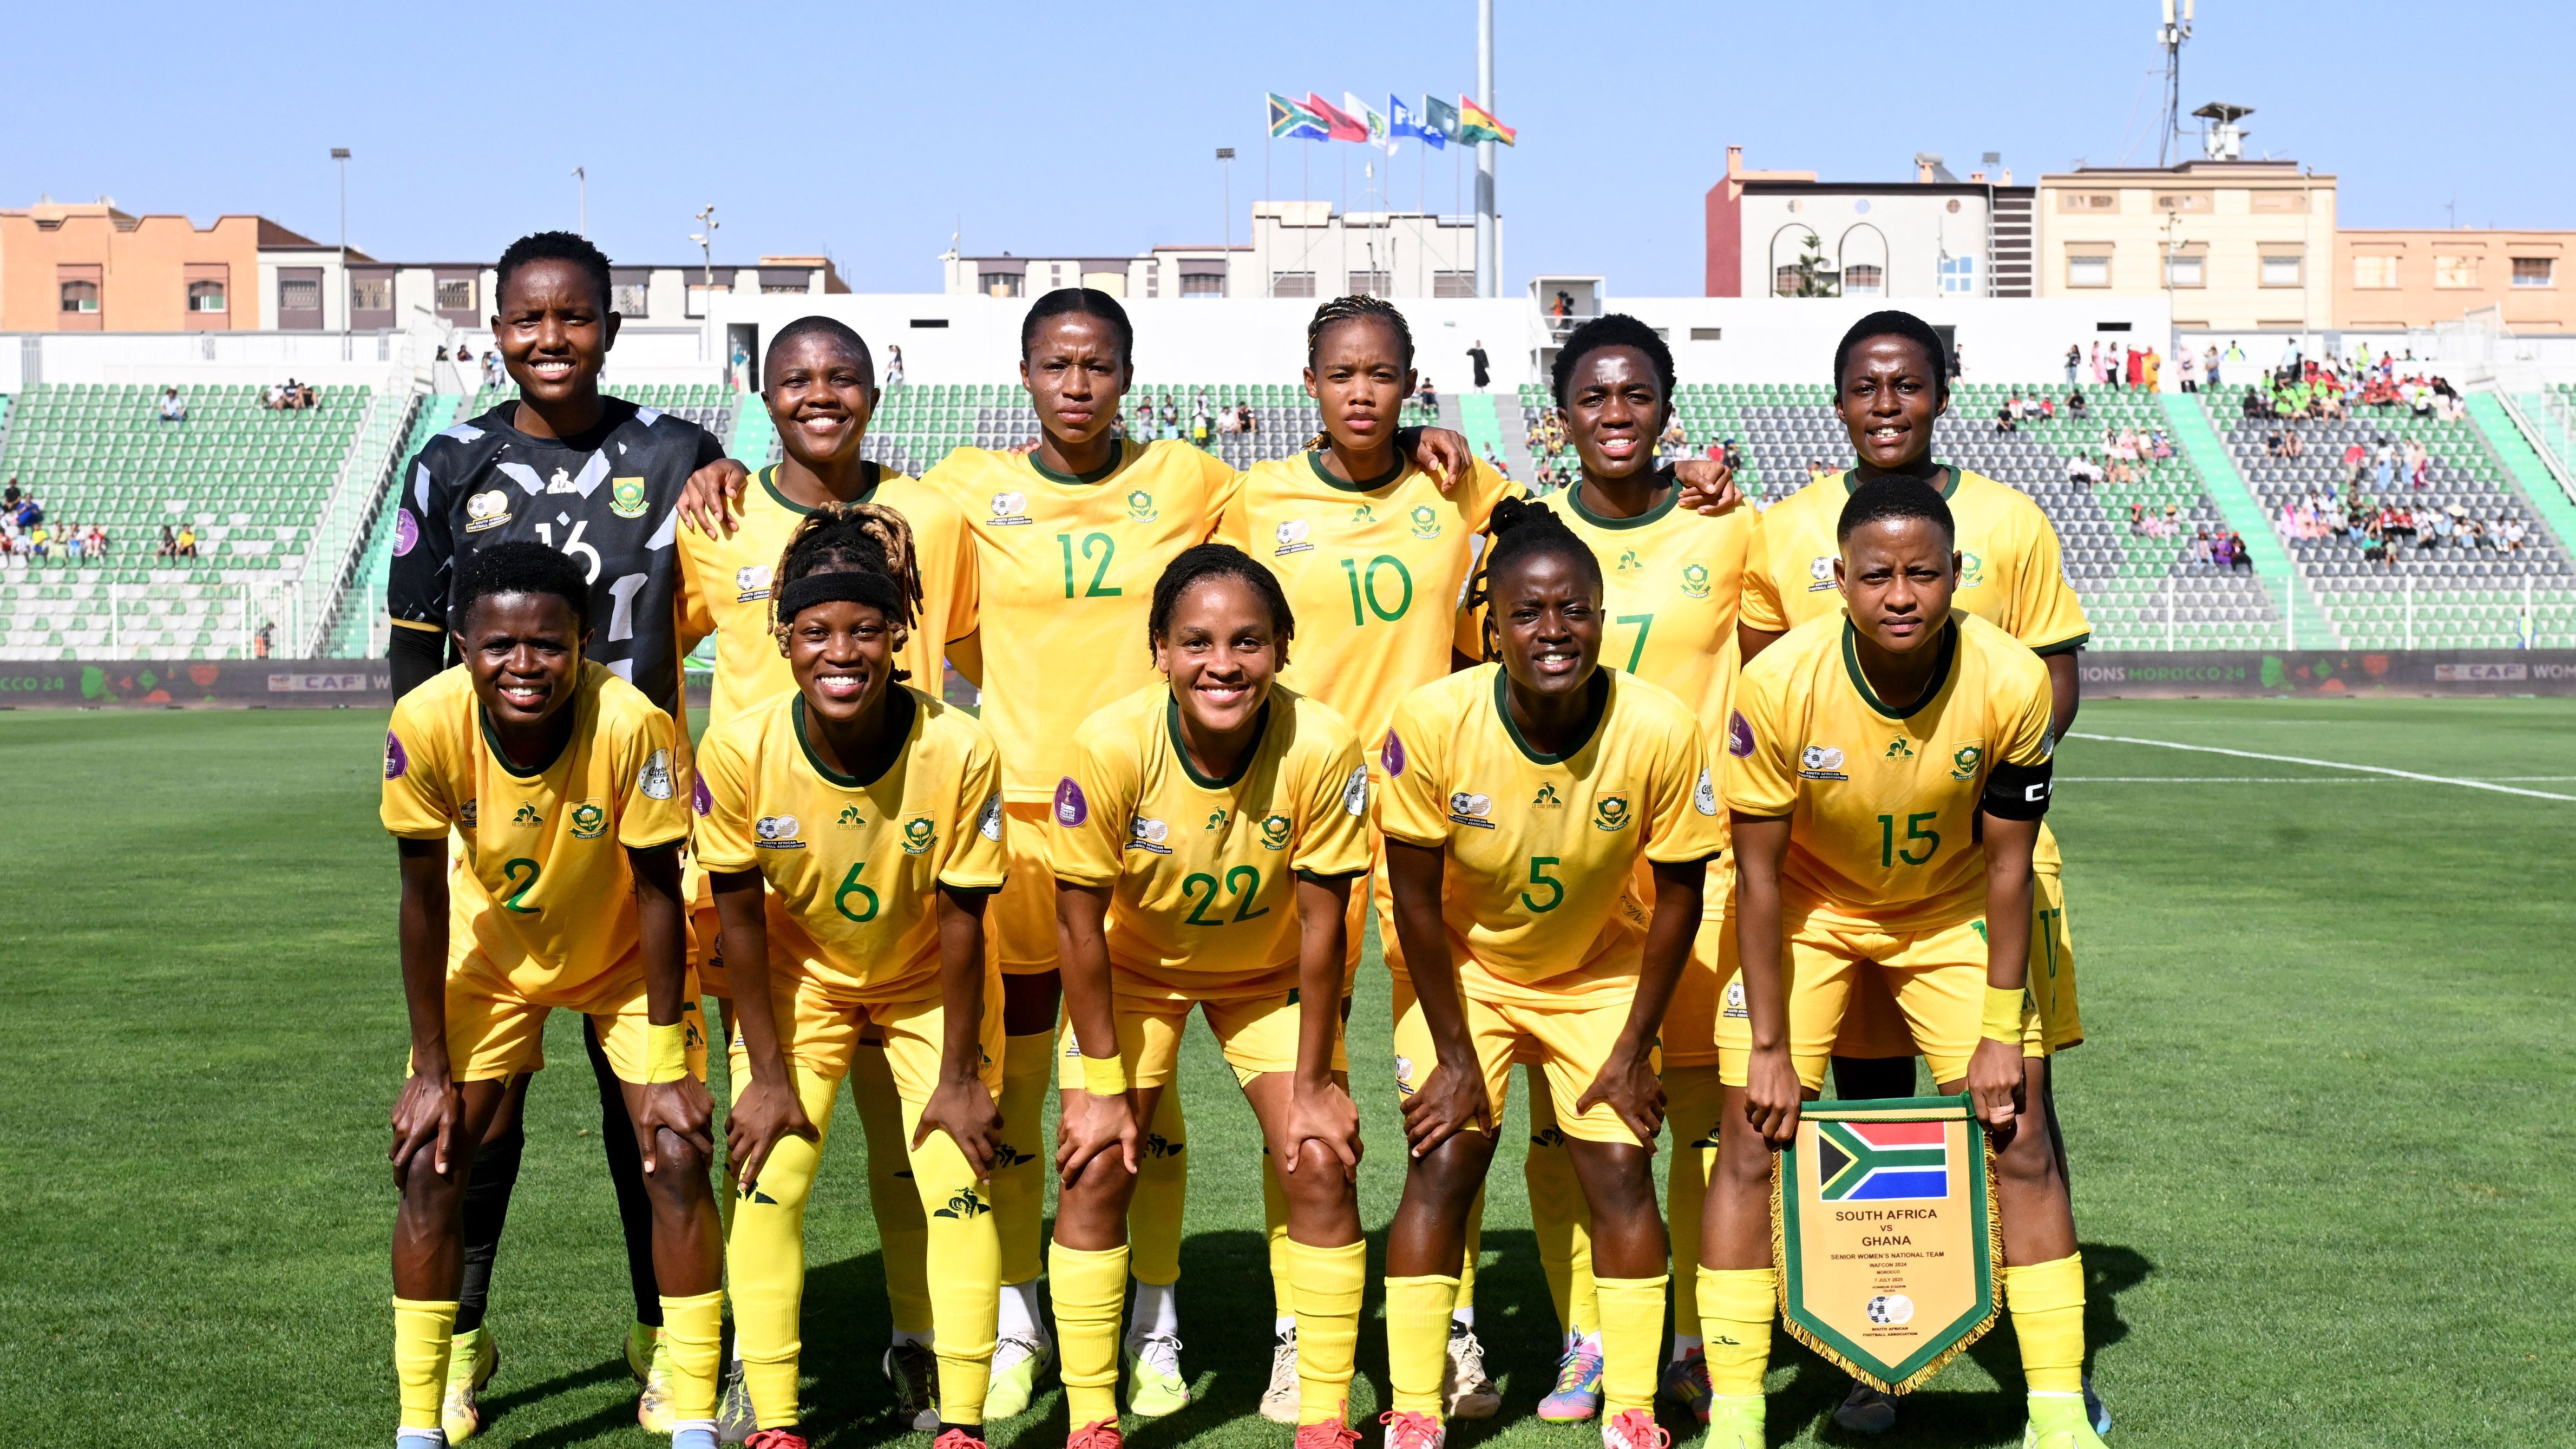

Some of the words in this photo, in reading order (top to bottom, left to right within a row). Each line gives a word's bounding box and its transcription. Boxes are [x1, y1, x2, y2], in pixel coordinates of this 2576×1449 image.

[1057, 532, 1122, 599] 12
[1341, 554, 1413, 626] 10
[1617, 614, 1654, 675] 7
[2127, 667, 2221, 681] MOROCCO
[2225, 666, 2246, 680] 24
[2469, 666, 2520, 678] CAF
[42, 676, 64, 691] 24
[304, 676, 356, 689] CAF
[1448, 816, 1467, 824] FOOTBALL
[1614, 821, 1627, 830] AFRICA
[592, 829, 607, 838] AFRICA
[1878, 811, 1940, 867] 15
[504, 858, 541, 914] 2
[834, 862, 879, 922] 6
[1522, 856, 1564, 913] 5
[1182, 865, 1269, 926] 22
[1836, 1211, 1883, 1221] SOUTH
[1886, 1209, 1937, 1220] AFRICA
[1861, 1235, 1912, 1247] GHANA
